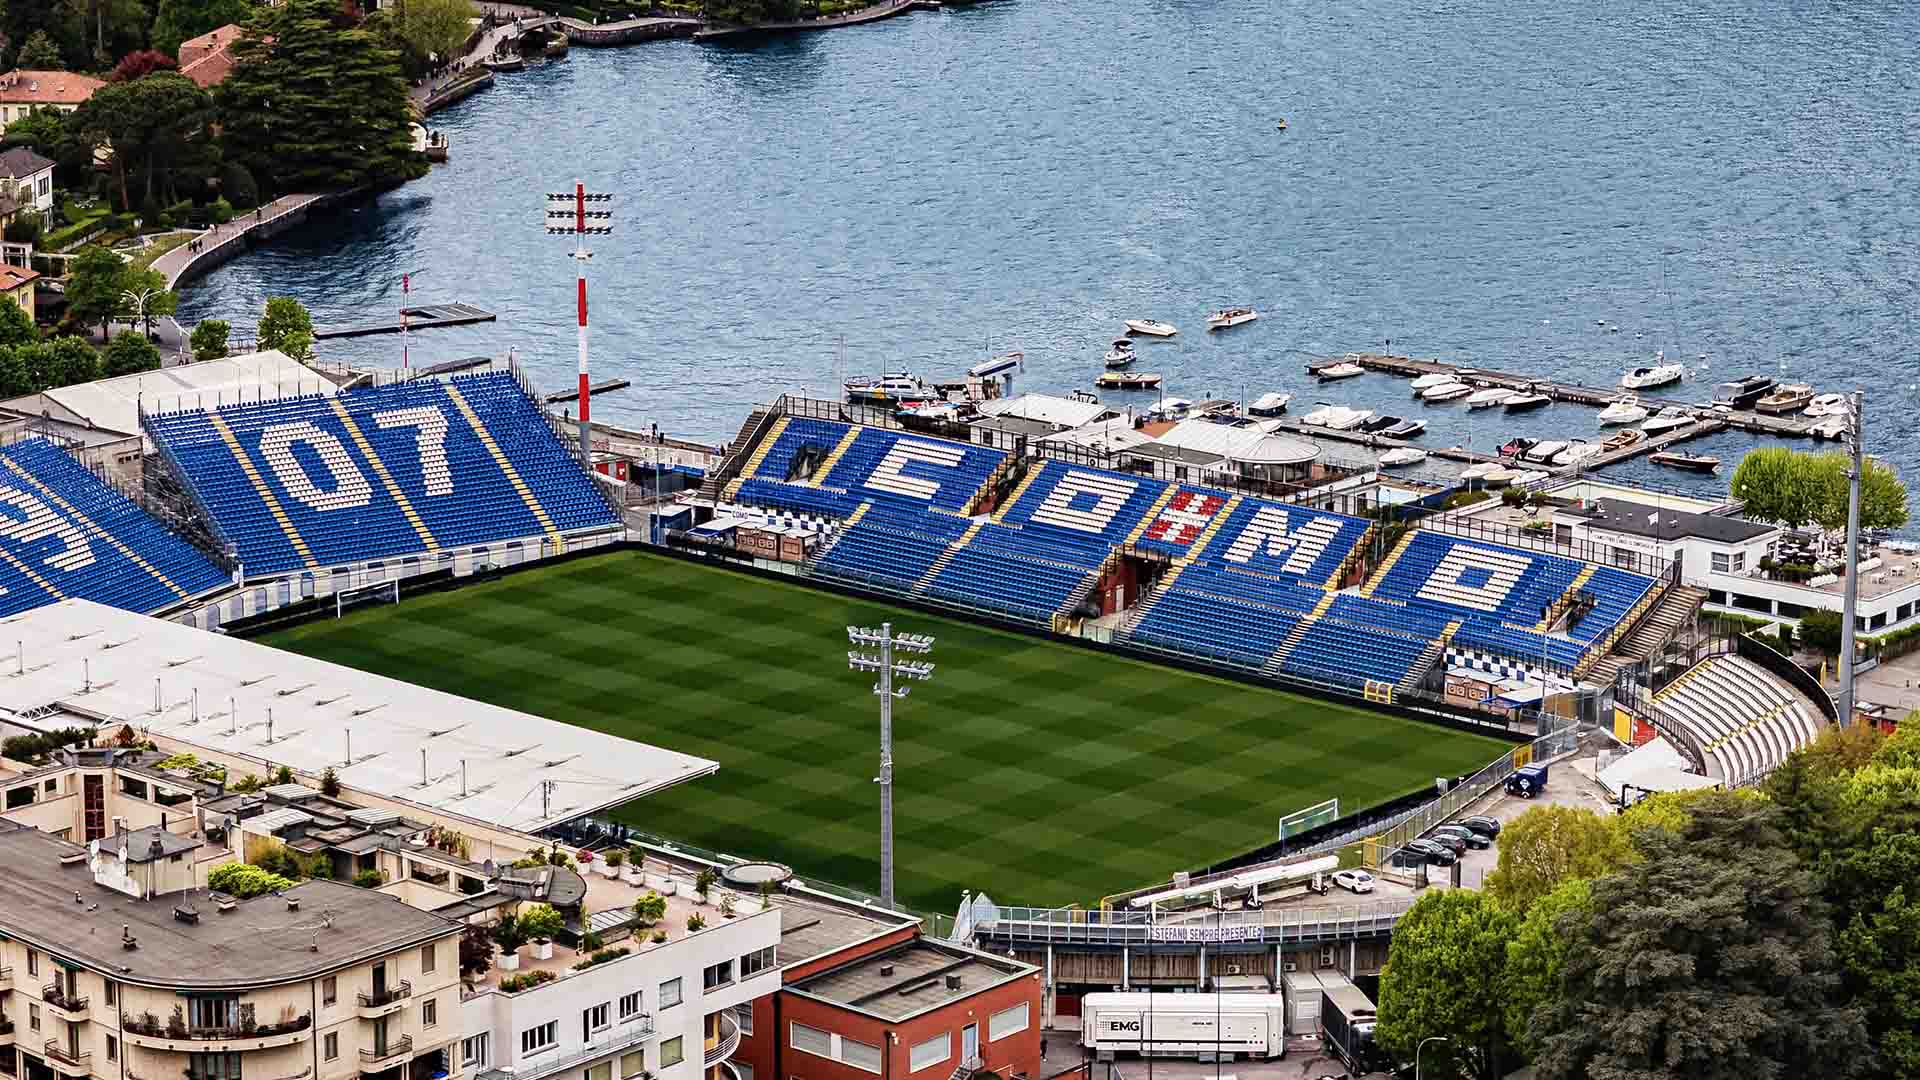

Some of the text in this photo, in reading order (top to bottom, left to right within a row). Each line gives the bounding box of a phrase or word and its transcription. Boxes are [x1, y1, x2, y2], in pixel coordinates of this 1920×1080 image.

[259, 405, 453, 511] 07
[1155, 926, 1257, 940] STEFANO SEMPRE PRESENTE
[1110, 1021, 1140, 1032] EMG
